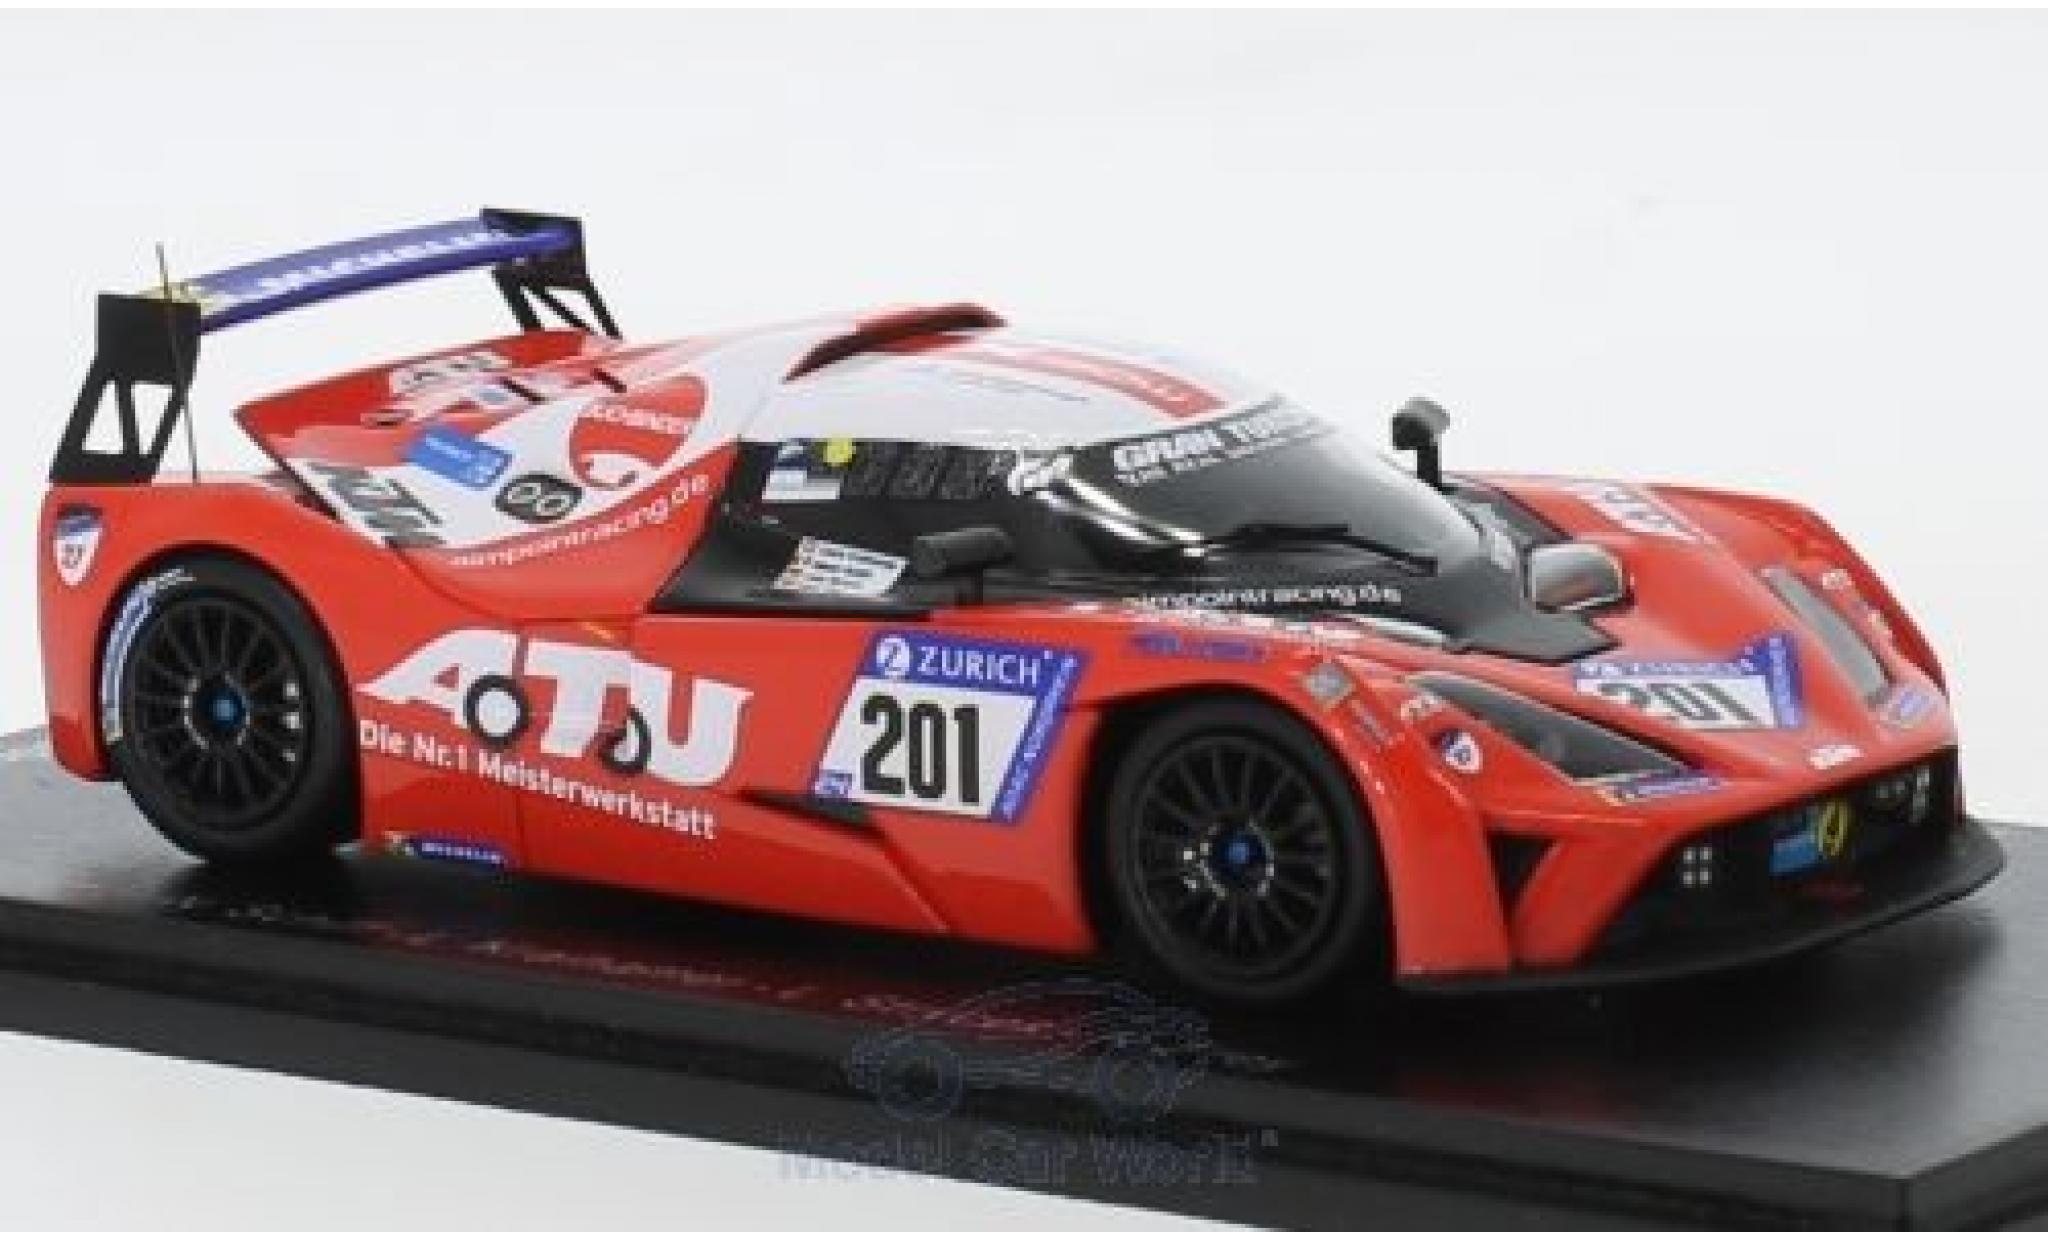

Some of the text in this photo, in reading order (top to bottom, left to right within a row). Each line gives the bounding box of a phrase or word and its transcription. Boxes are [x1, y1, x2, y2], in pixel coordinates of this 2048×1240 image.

[1112, 427, 1223, 471] GRAN
[916, 645, 1041, 688] ZURICH
[359, 718, 407, 755] Die
[478, 749, 718, 840] Meisterwerkstatt
[859, 694, 980, 806] 201
